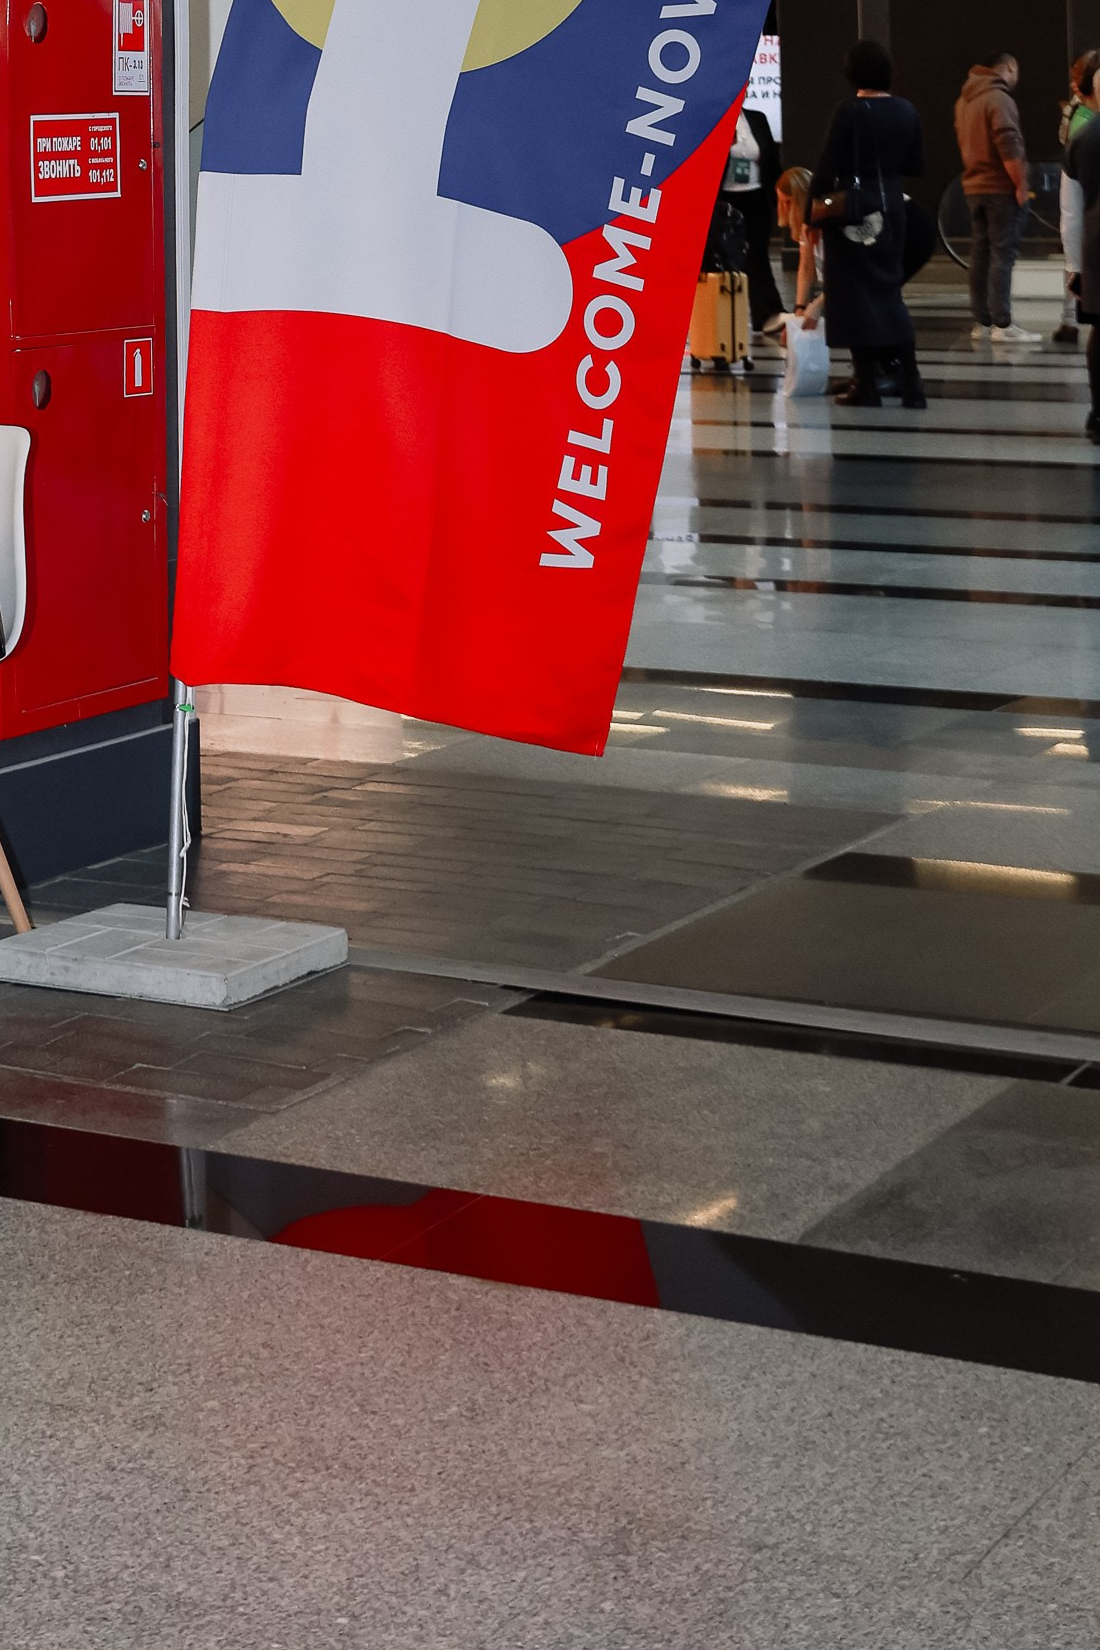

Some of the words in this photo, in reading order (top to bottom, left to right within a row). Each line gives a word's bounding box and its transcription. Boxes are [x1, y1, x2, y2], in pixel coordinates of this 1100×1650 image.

[37, 137, 52, 152] ПРИ
[52, 136, 82, 152] ПОЖАРЕ
[38, 159, 81, 180] ЗВОНИТЬ
[88, 168, 115, 185] 101,112
